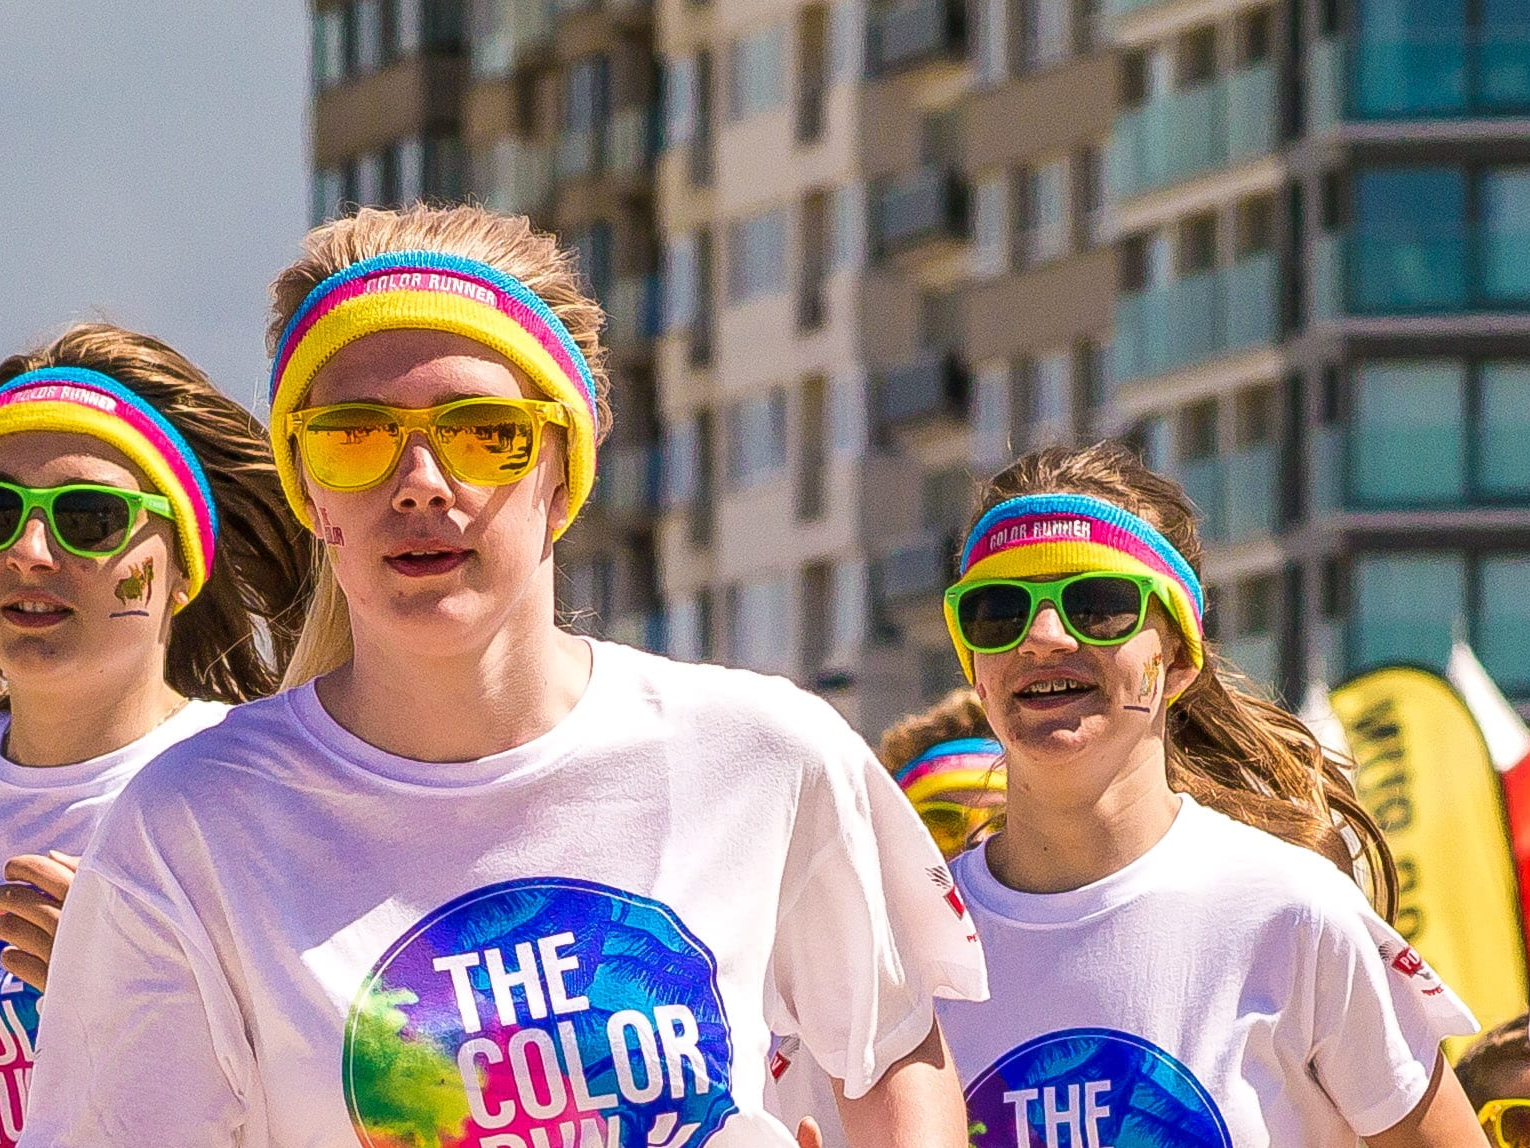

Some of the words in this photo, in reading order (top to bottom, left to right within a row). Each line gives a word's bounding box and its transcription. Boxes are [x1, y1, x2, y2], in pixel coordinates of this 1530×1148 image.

[365, 273, 422, 294] COLOR
[429, 274, 497, 304] RUNNER
[60, 386, 117, 411] RUNNER
[989, 523, 1027, 550] COLOR
[1033, 520, 1090, 541] RUNNER
[432, 931, 590, 1034] THE
[457, 1003, 711, 1130] COLOR
